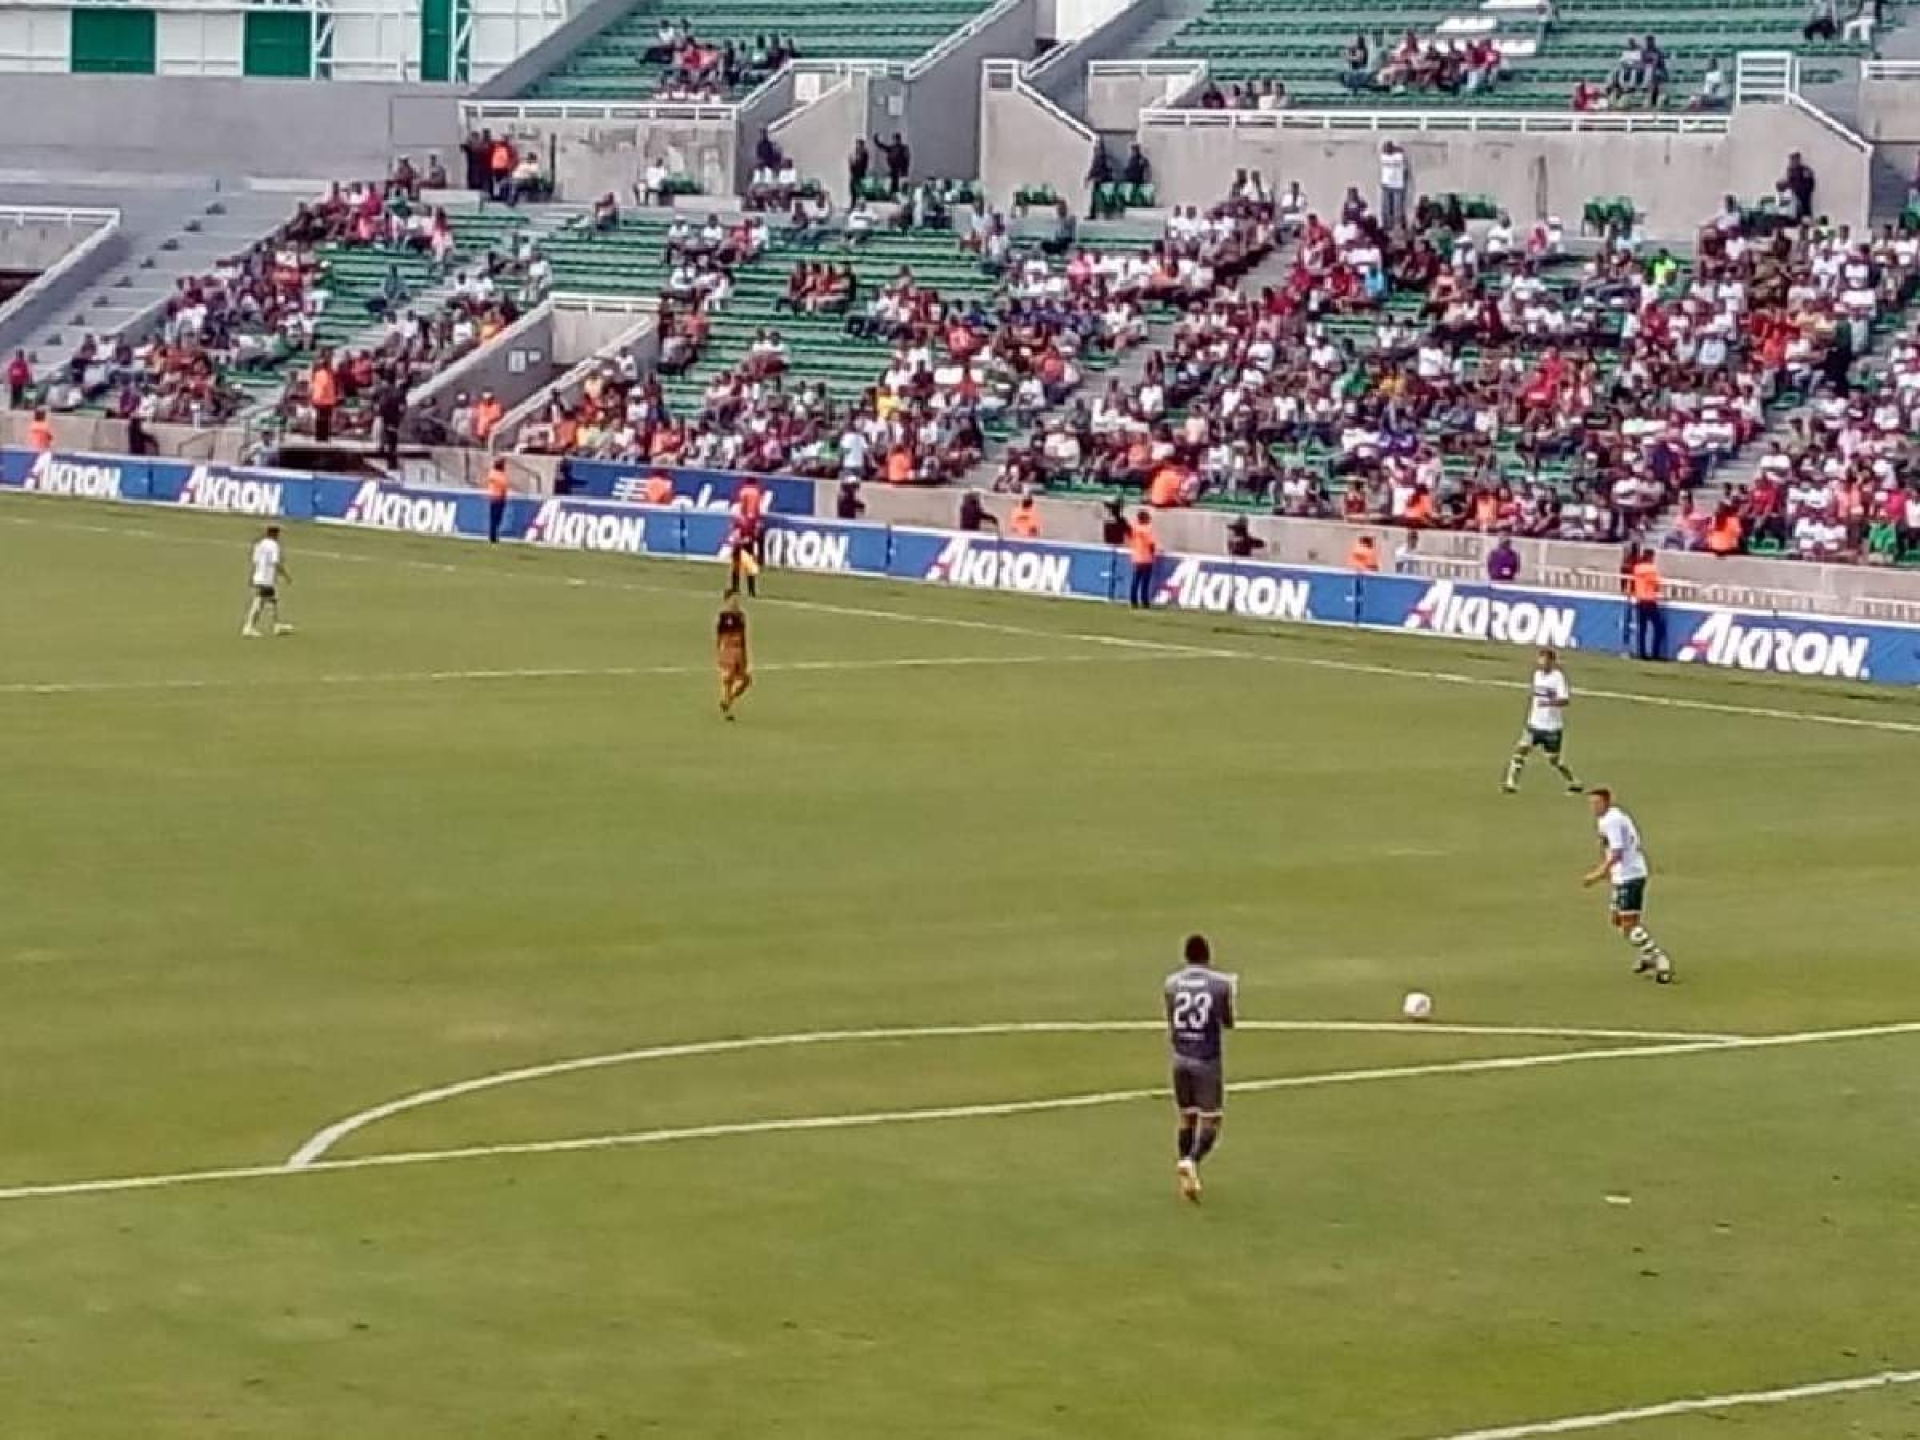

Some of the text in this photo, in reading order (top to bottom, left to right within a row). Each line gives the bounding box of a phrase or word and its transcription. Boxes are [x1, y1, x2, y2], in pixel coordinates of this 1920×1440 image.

[179, 464, 282, 515] AKRON
[346, 480, 456, 533] AKRON
[526, 499, 647, 552] AKRON
[926, 537, 1070, 594] AKRON
[1154, 558, 1311, 619] AKRON
[1404, 579, 1577, 648] AKRON
[1677, 613, 1869, 679] AKRON
[1174, 991, 1213, 1030] 23
